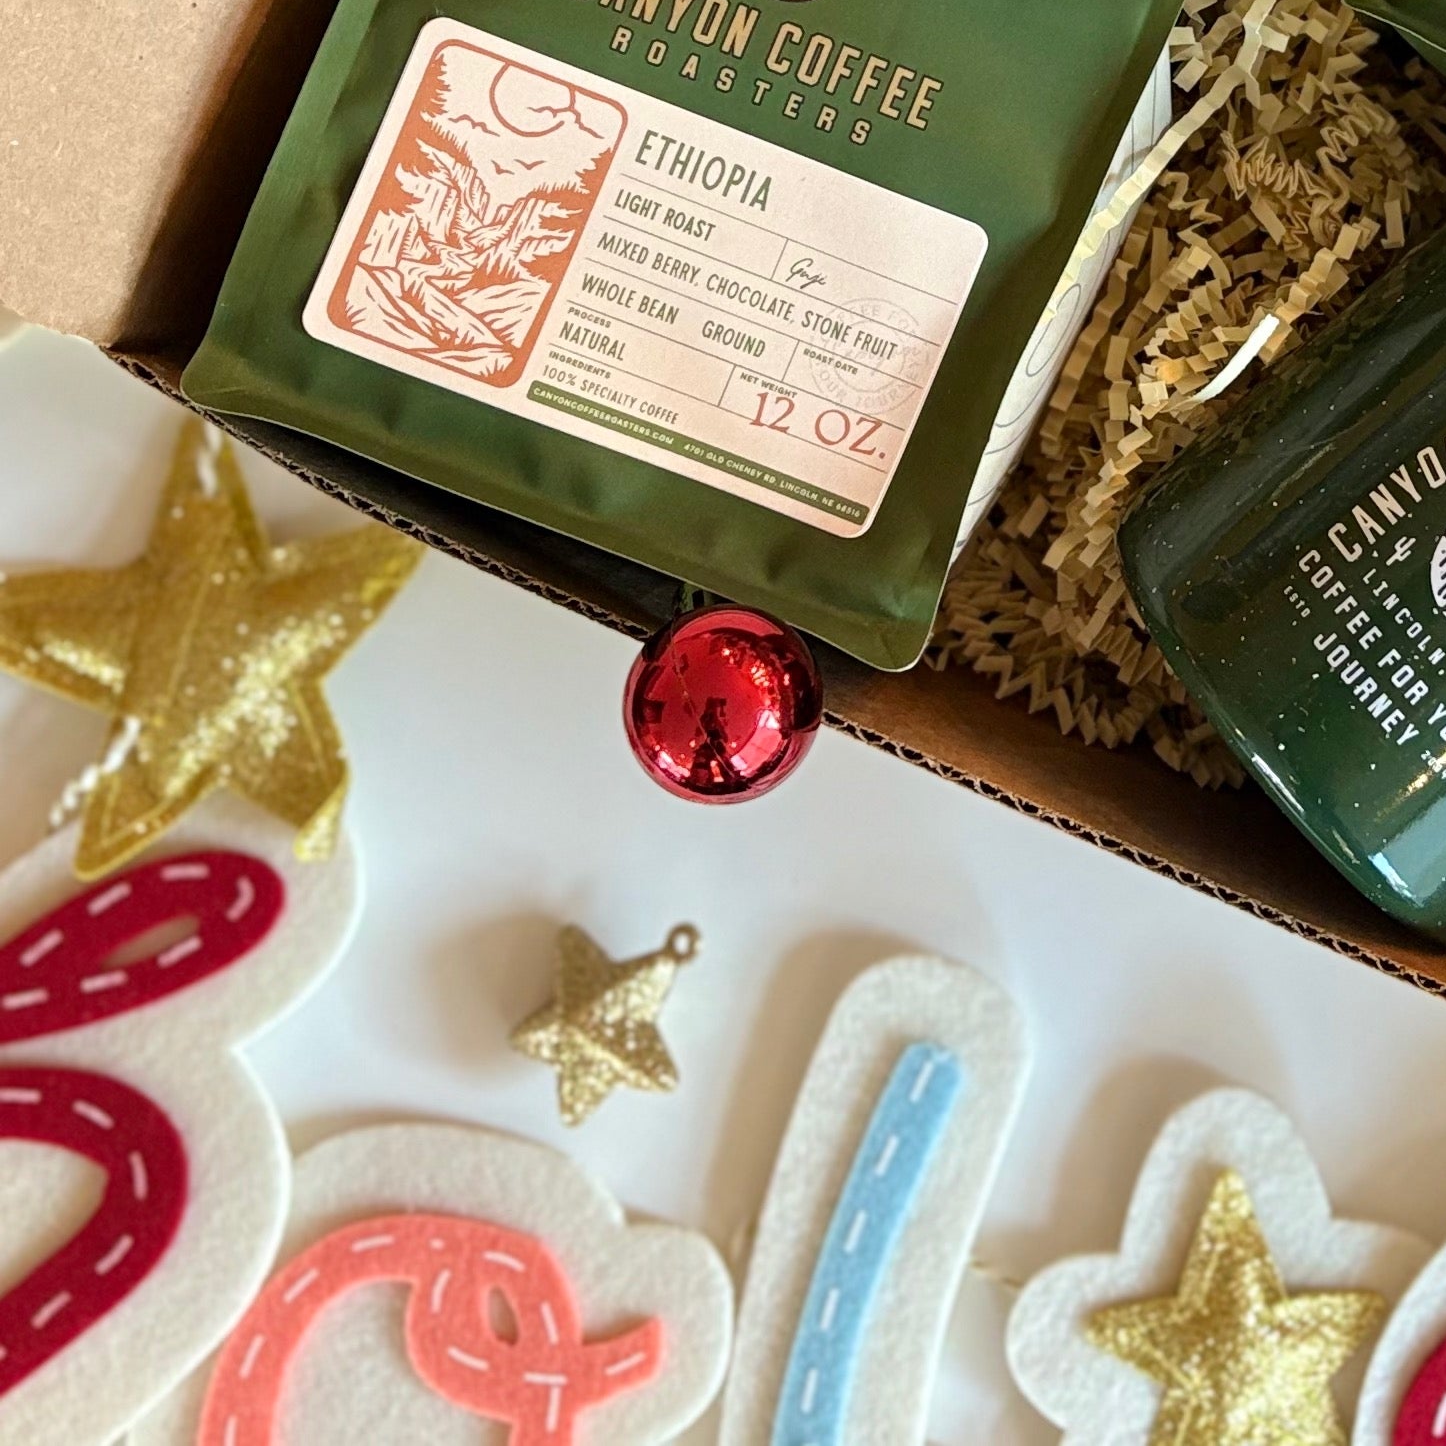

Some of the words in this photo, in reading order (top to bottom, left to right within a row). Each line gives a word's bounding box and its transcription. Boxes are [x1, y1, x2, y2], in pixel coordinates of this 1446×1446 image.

[609, 25, 872, 146] ROASTERS
[764, 21, 944, 131] COFFEE
[634, 129, 772, 212] ETHIOPIA
[614, 189, 663, 221] LIGHT
[662, 207, 717, 242] ROAST
[567, 306, 612, 329] PROCESS
[581, 273, 637, 309] WHOLE
[637, 295, 680, 325] BEAN
[596, 231, 649, 265] MIXED
[651, 252, 701, 287] BERRY,
[706, 273, 795, 324] CHOCOLATE,
[801, 310, 853, 344] STONE
[853, 330, 898, 360] FRUIT
[548, 350, 611, 379] INGREDIENTS
[559, 320, 626, 361] NATURAL
[701, 320, 766, 358] GROUND
[803, 348, 835, 365] ROAST
[834, 360, 859, 375] DATE
[542, 364, 577, 387] 100%
[579, 379, 638, 409] SPECIALTY
[639, 401, 679, 425] COFFEE
[740, 372, 759, 384] NET
[761, 380, 798, 402] WEIGHT
[750, 392, 795, 434] 12
[814, 412, 887, 460] OZ.
[705, 451, 725, 464] OLD
[821, 497, 835, 507] NE
[1283, 585, 1312, 619] ESTD
[1298, 549, 1383, 651] COFFEE
[1377, 648, 1429, 706] FOR
[1313, 632, 1420, 746] JOURNEY
